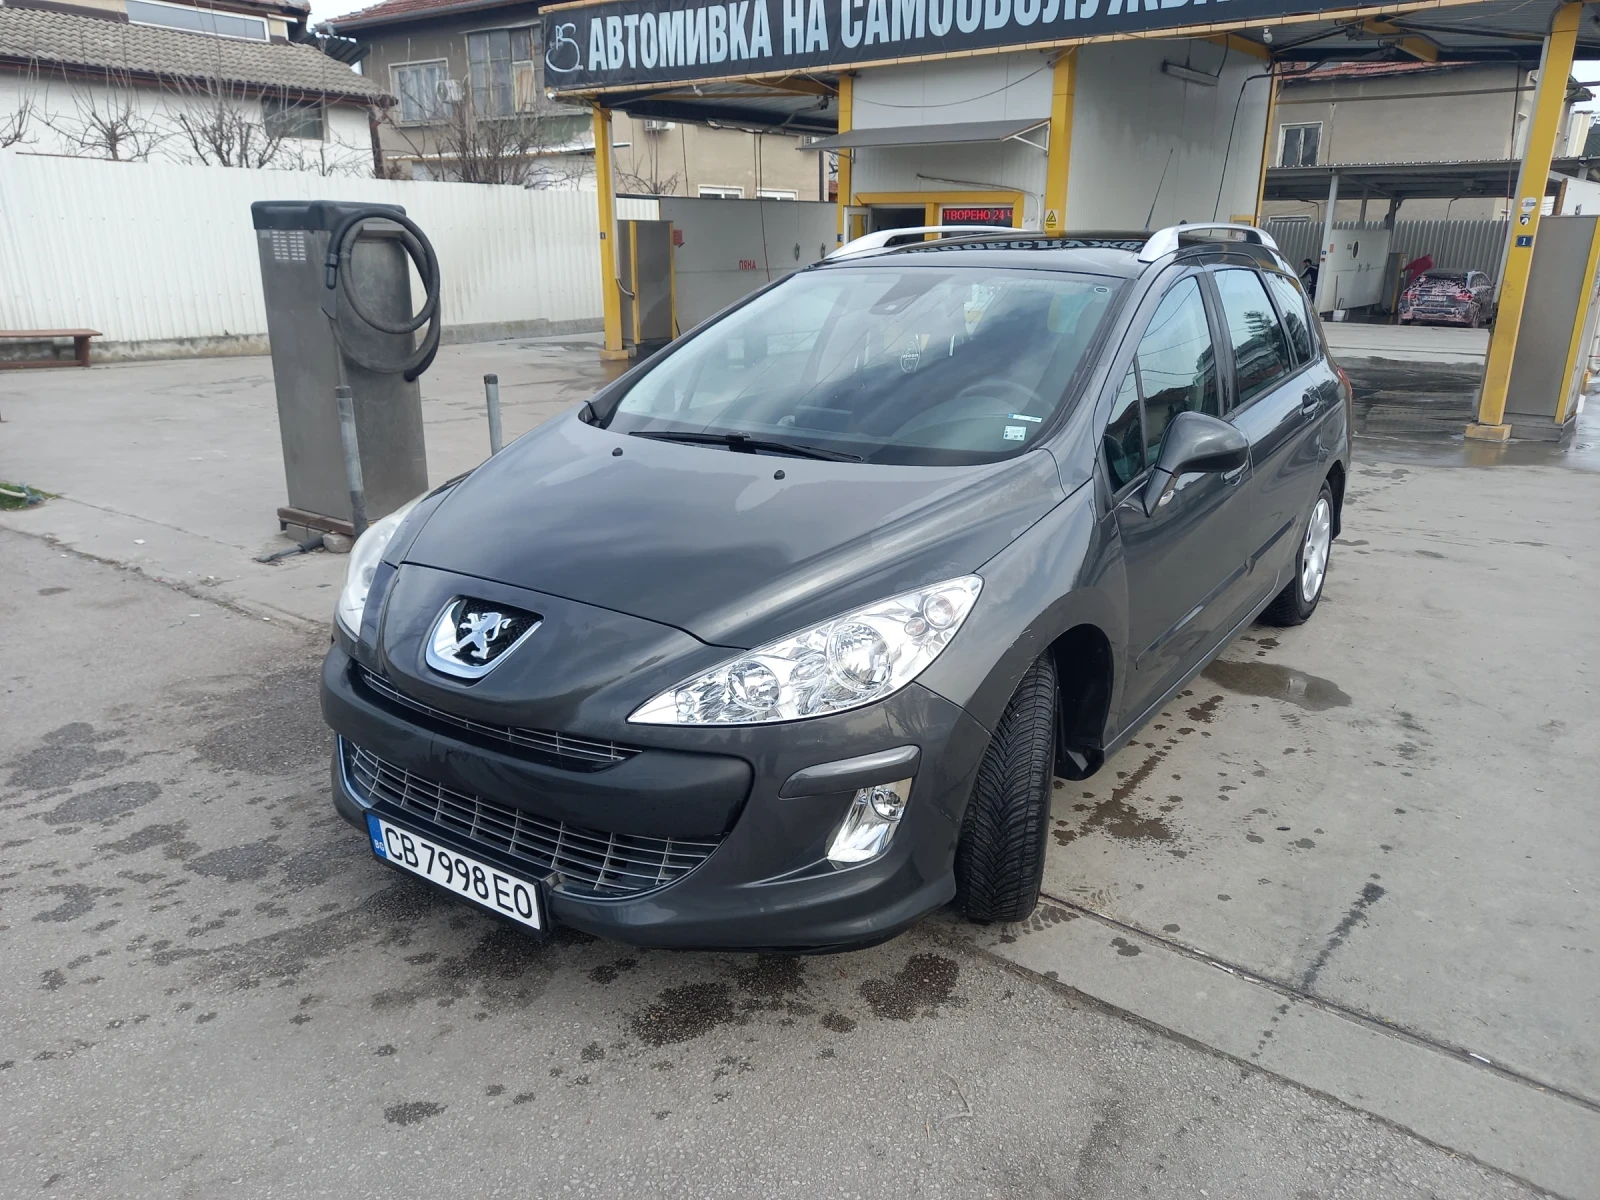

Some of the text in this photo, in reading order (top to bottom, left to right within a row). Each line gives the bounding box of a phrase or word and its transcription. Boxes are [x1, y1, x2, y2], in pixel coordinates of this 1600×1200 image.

[588, 0, 772, 71] АВТОМИВКА
[783, 0, 829, 55] НА
[943, 209, 990, 221] ТВОРЕНО
[993, 209, 1005, 221] 24
[739, 259, 756, 271] ПЯНА
